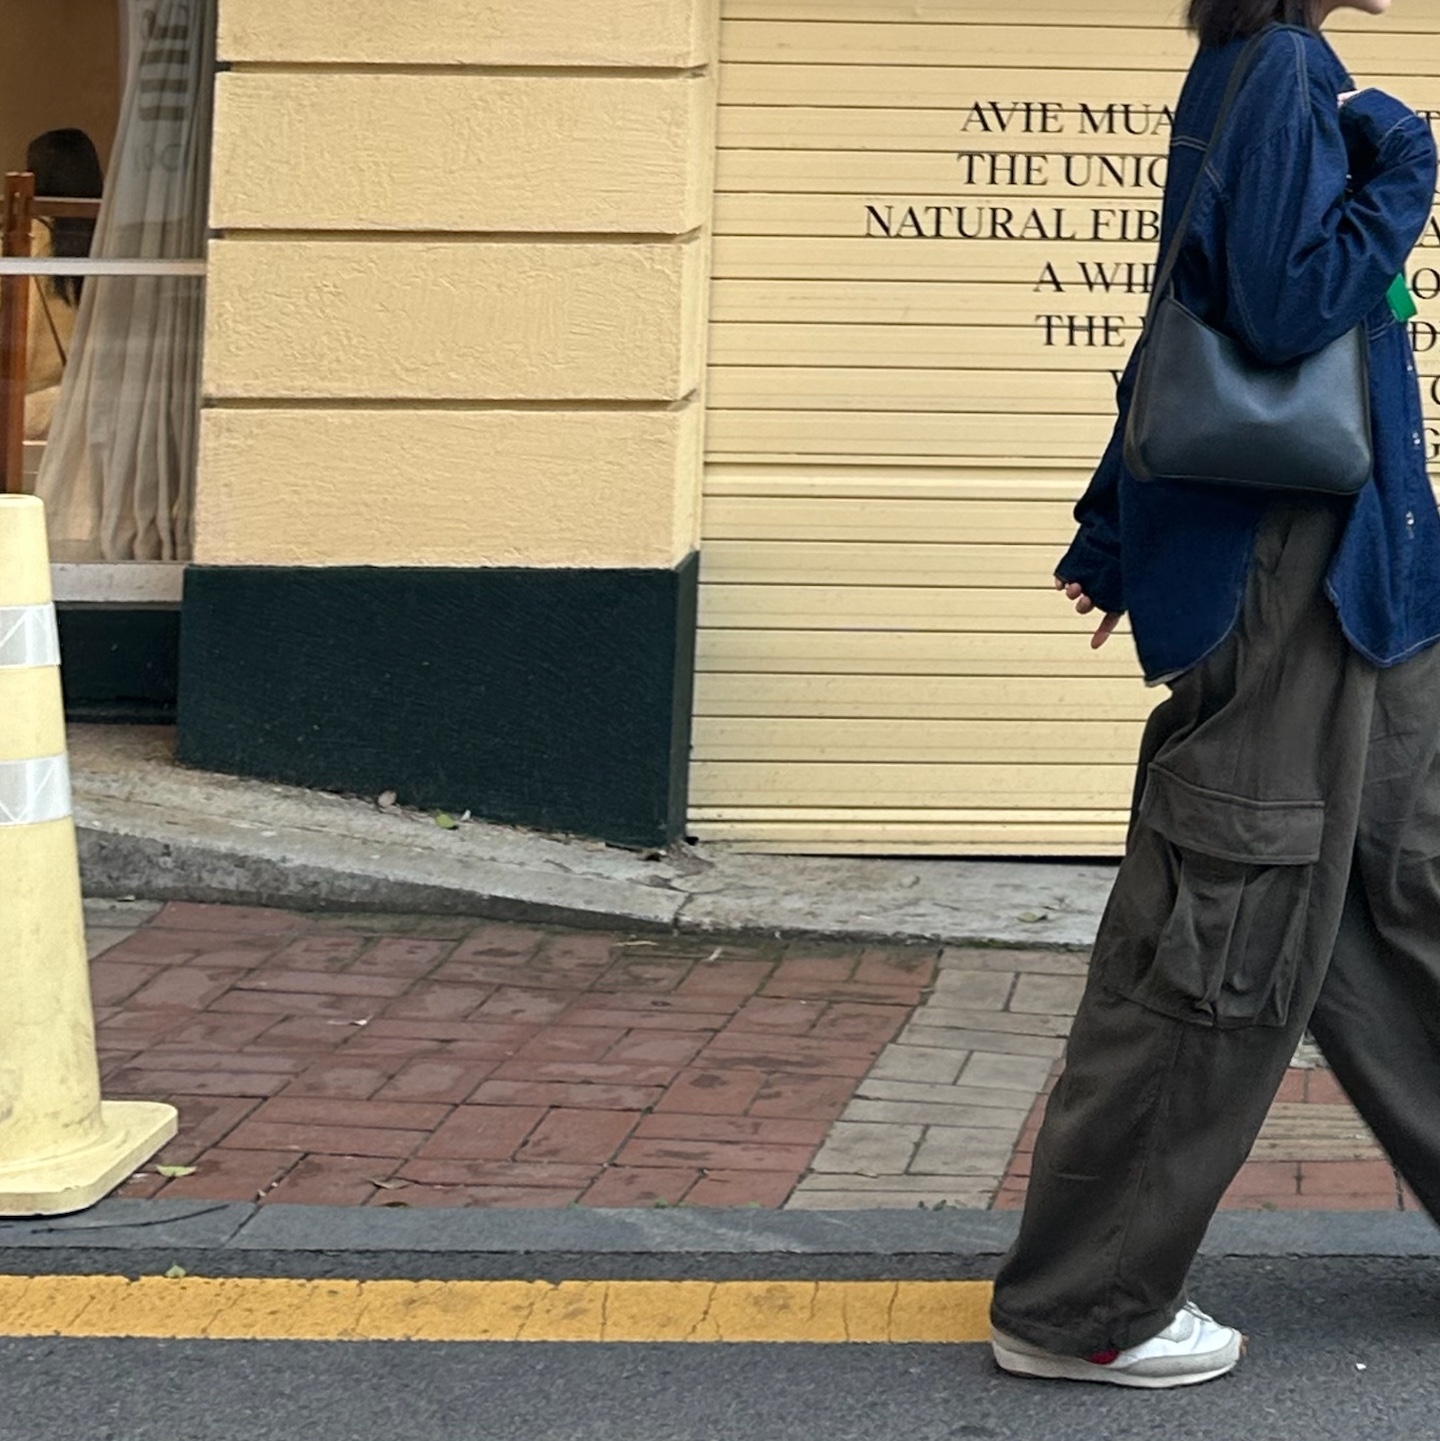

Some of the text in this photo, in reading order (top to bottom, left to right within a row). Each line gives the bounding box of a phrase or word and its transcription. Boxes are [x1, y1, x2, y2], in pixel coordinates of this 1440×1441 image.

[960, 101, 1063, 133] AVIE
[1078, 102, 1174, 135] MUA
[957, 153, 1048, 185] THE
[864, 205, 1077, 239] NATURAL
[1091, 208, 1160, 241] FIB
[1032, 261, 1066, 293] A
[1077, 261, 1158, 294] WI
[1035, 315, 1126, 347] THE
